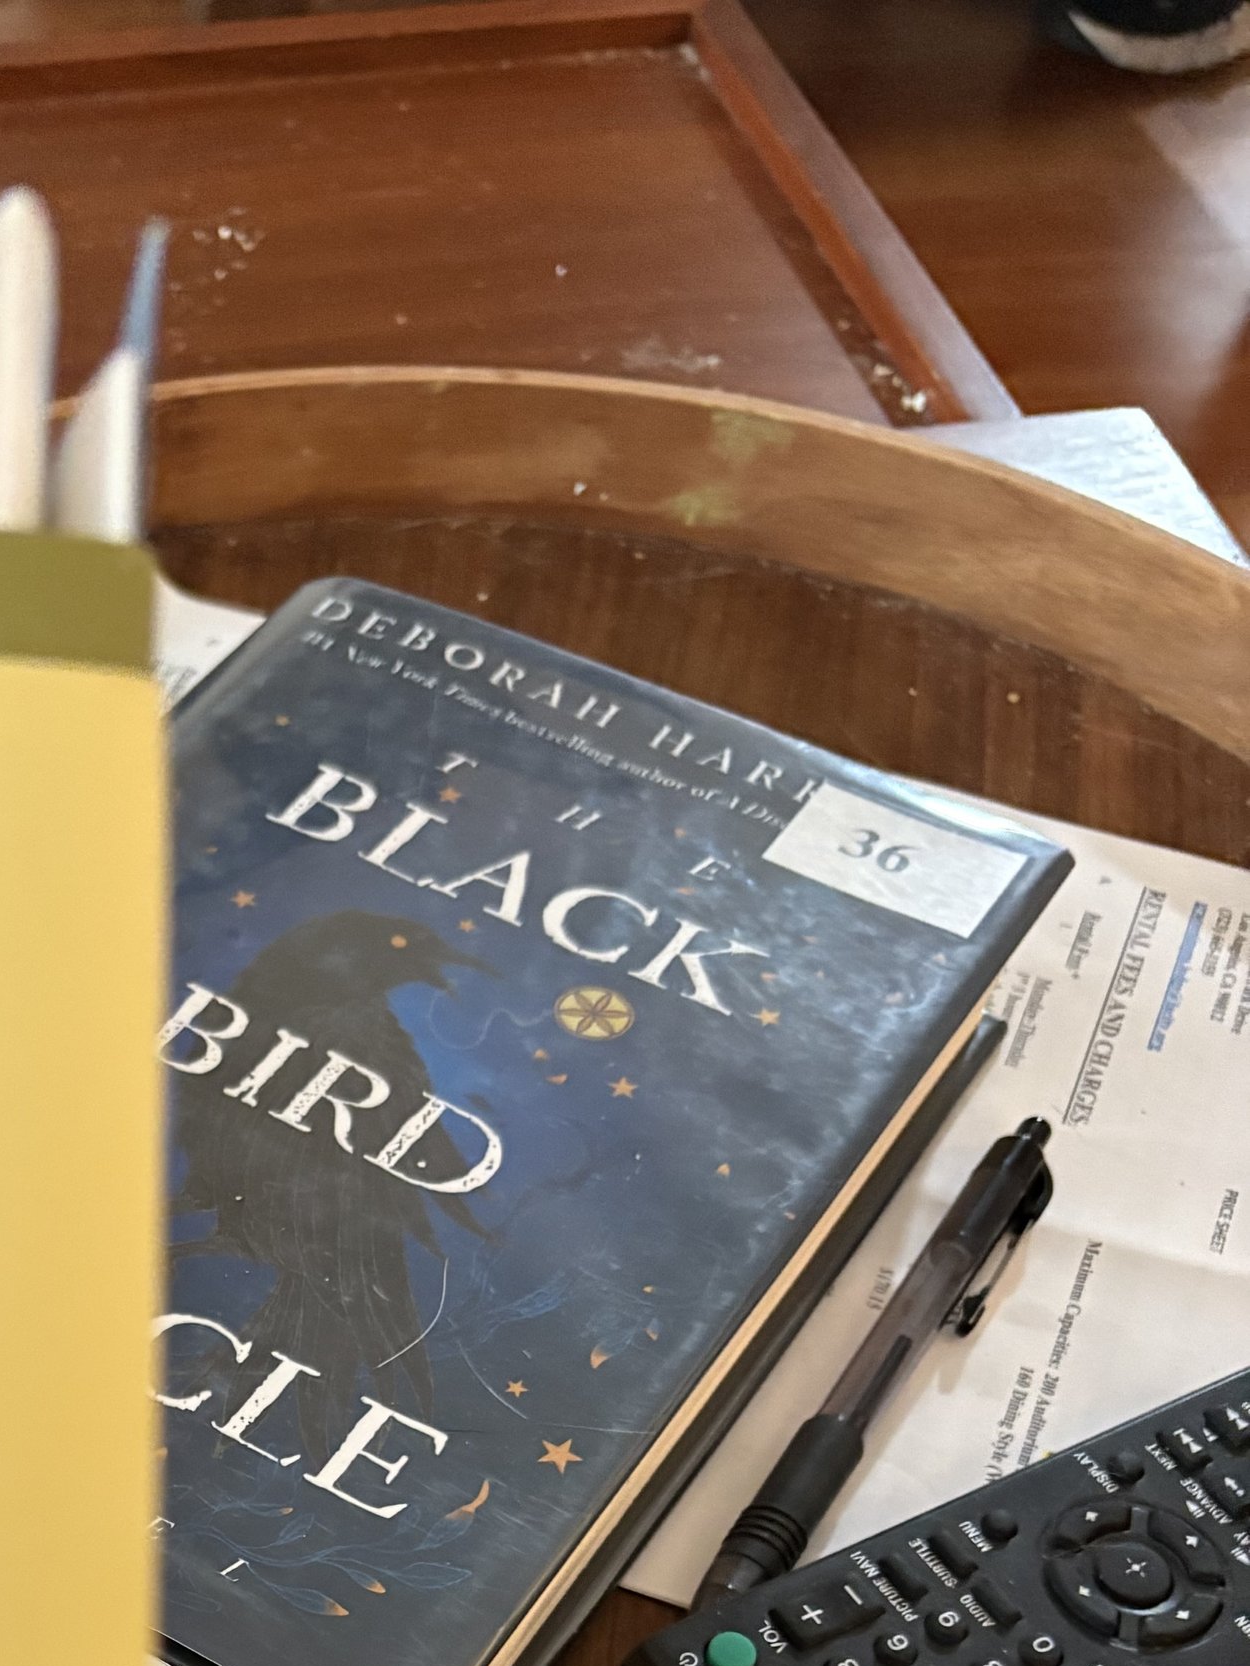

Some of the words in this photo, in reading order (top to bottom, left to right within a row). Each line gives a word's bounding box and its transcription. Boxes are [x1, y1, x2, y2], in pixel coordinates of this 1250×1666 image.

[311, 597, 621, 729] DEBORAH
[648, 723, 824, 803] HAR
[503, 710, 615, 769] bestselling
[616, 758, 688, 792] author
[690, 784, 724, 801] of
[837, 828, 922, 874] 36
[265, 763, 770, 1017] BLACK
[1131, 888, 1167, 950] RENTAL
[1114, 955, 1145, 996] FEES
[1100, 1000, 1127, 1036] AND
[154, 982, 502, 1194] BIRD
[1218, 1188, 1239, 1220] PRICE
[1210, 1220, 1231, 1255] SHEET
[1070, 1239, 1103, 1302] Maximum
[1048, 1304, 1081, 1369] Capacities:
[1015, 1366, 1034, 1388] 160
[1041, 1374, 1060, 1397] 200
[148, 1313, 448, 1519] CLE
[998, 1389, 1026, 1431] Dining
[989, 1431, 1014, 1465] Style
[1017, 1398, 1051, 1468] Auditorium
[1073, 1451, 1120, 1494] DISPLAY
[1144, 1442, 1178, 1472] NEXT
[1179, 1477, 1234, 1525] ADVANCE
[958, 1520, 993, 1553] MENU
[850, 1550, 880, 1579] NAVI
[908, 1536, 959, 1589] SUBTITLE
[872, 1576, 919, 1623] PICTURE
[960, 1593, 996, 1629] AUDIO
[758, 1619, 789, 1654] VOL
[1032, 1636, 1056, 1653] 0
